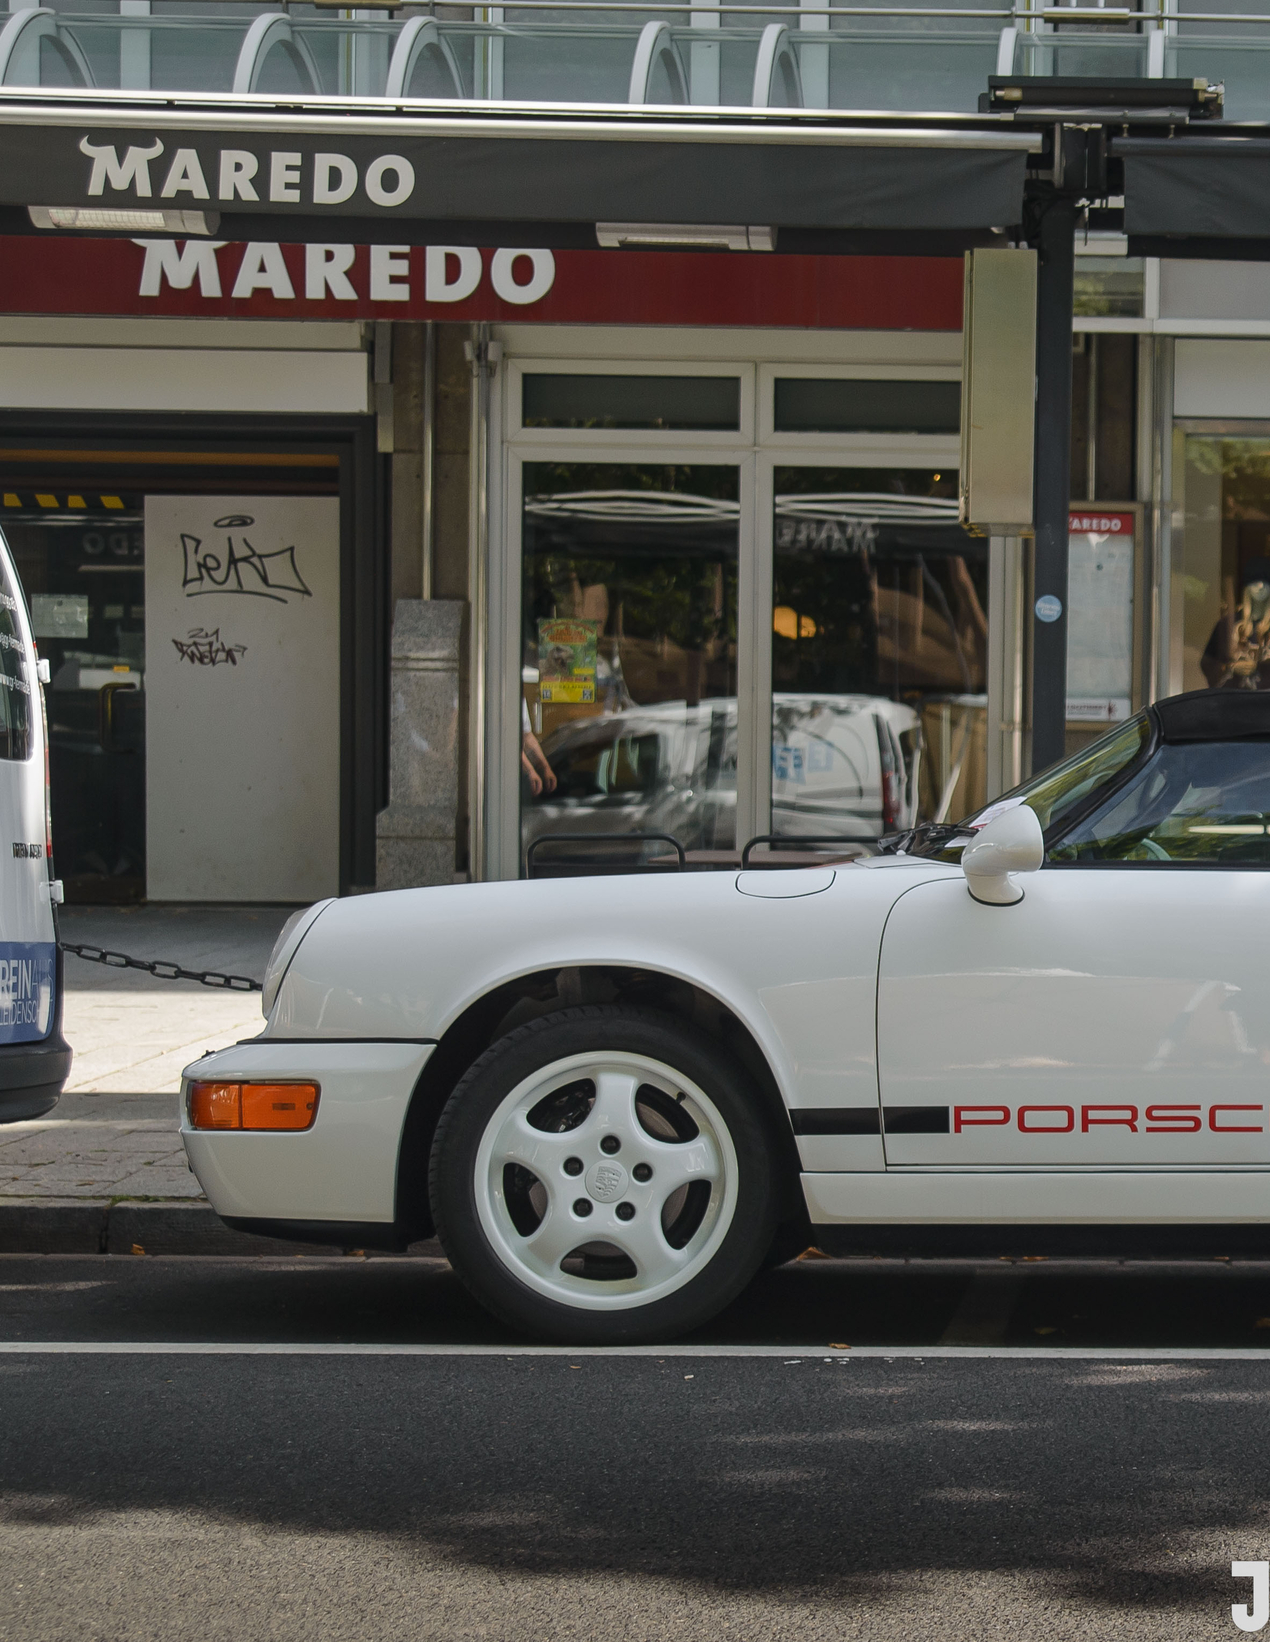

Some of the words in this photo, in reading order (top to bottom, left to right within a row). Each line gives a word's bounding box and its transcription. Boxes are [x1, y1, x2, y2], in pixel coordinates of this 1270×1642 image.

[79, 135, 416, 207] MAREDO
[131, 239, 556, 305] MAREDO
[1068, 517, 1122, 532] AREDO
